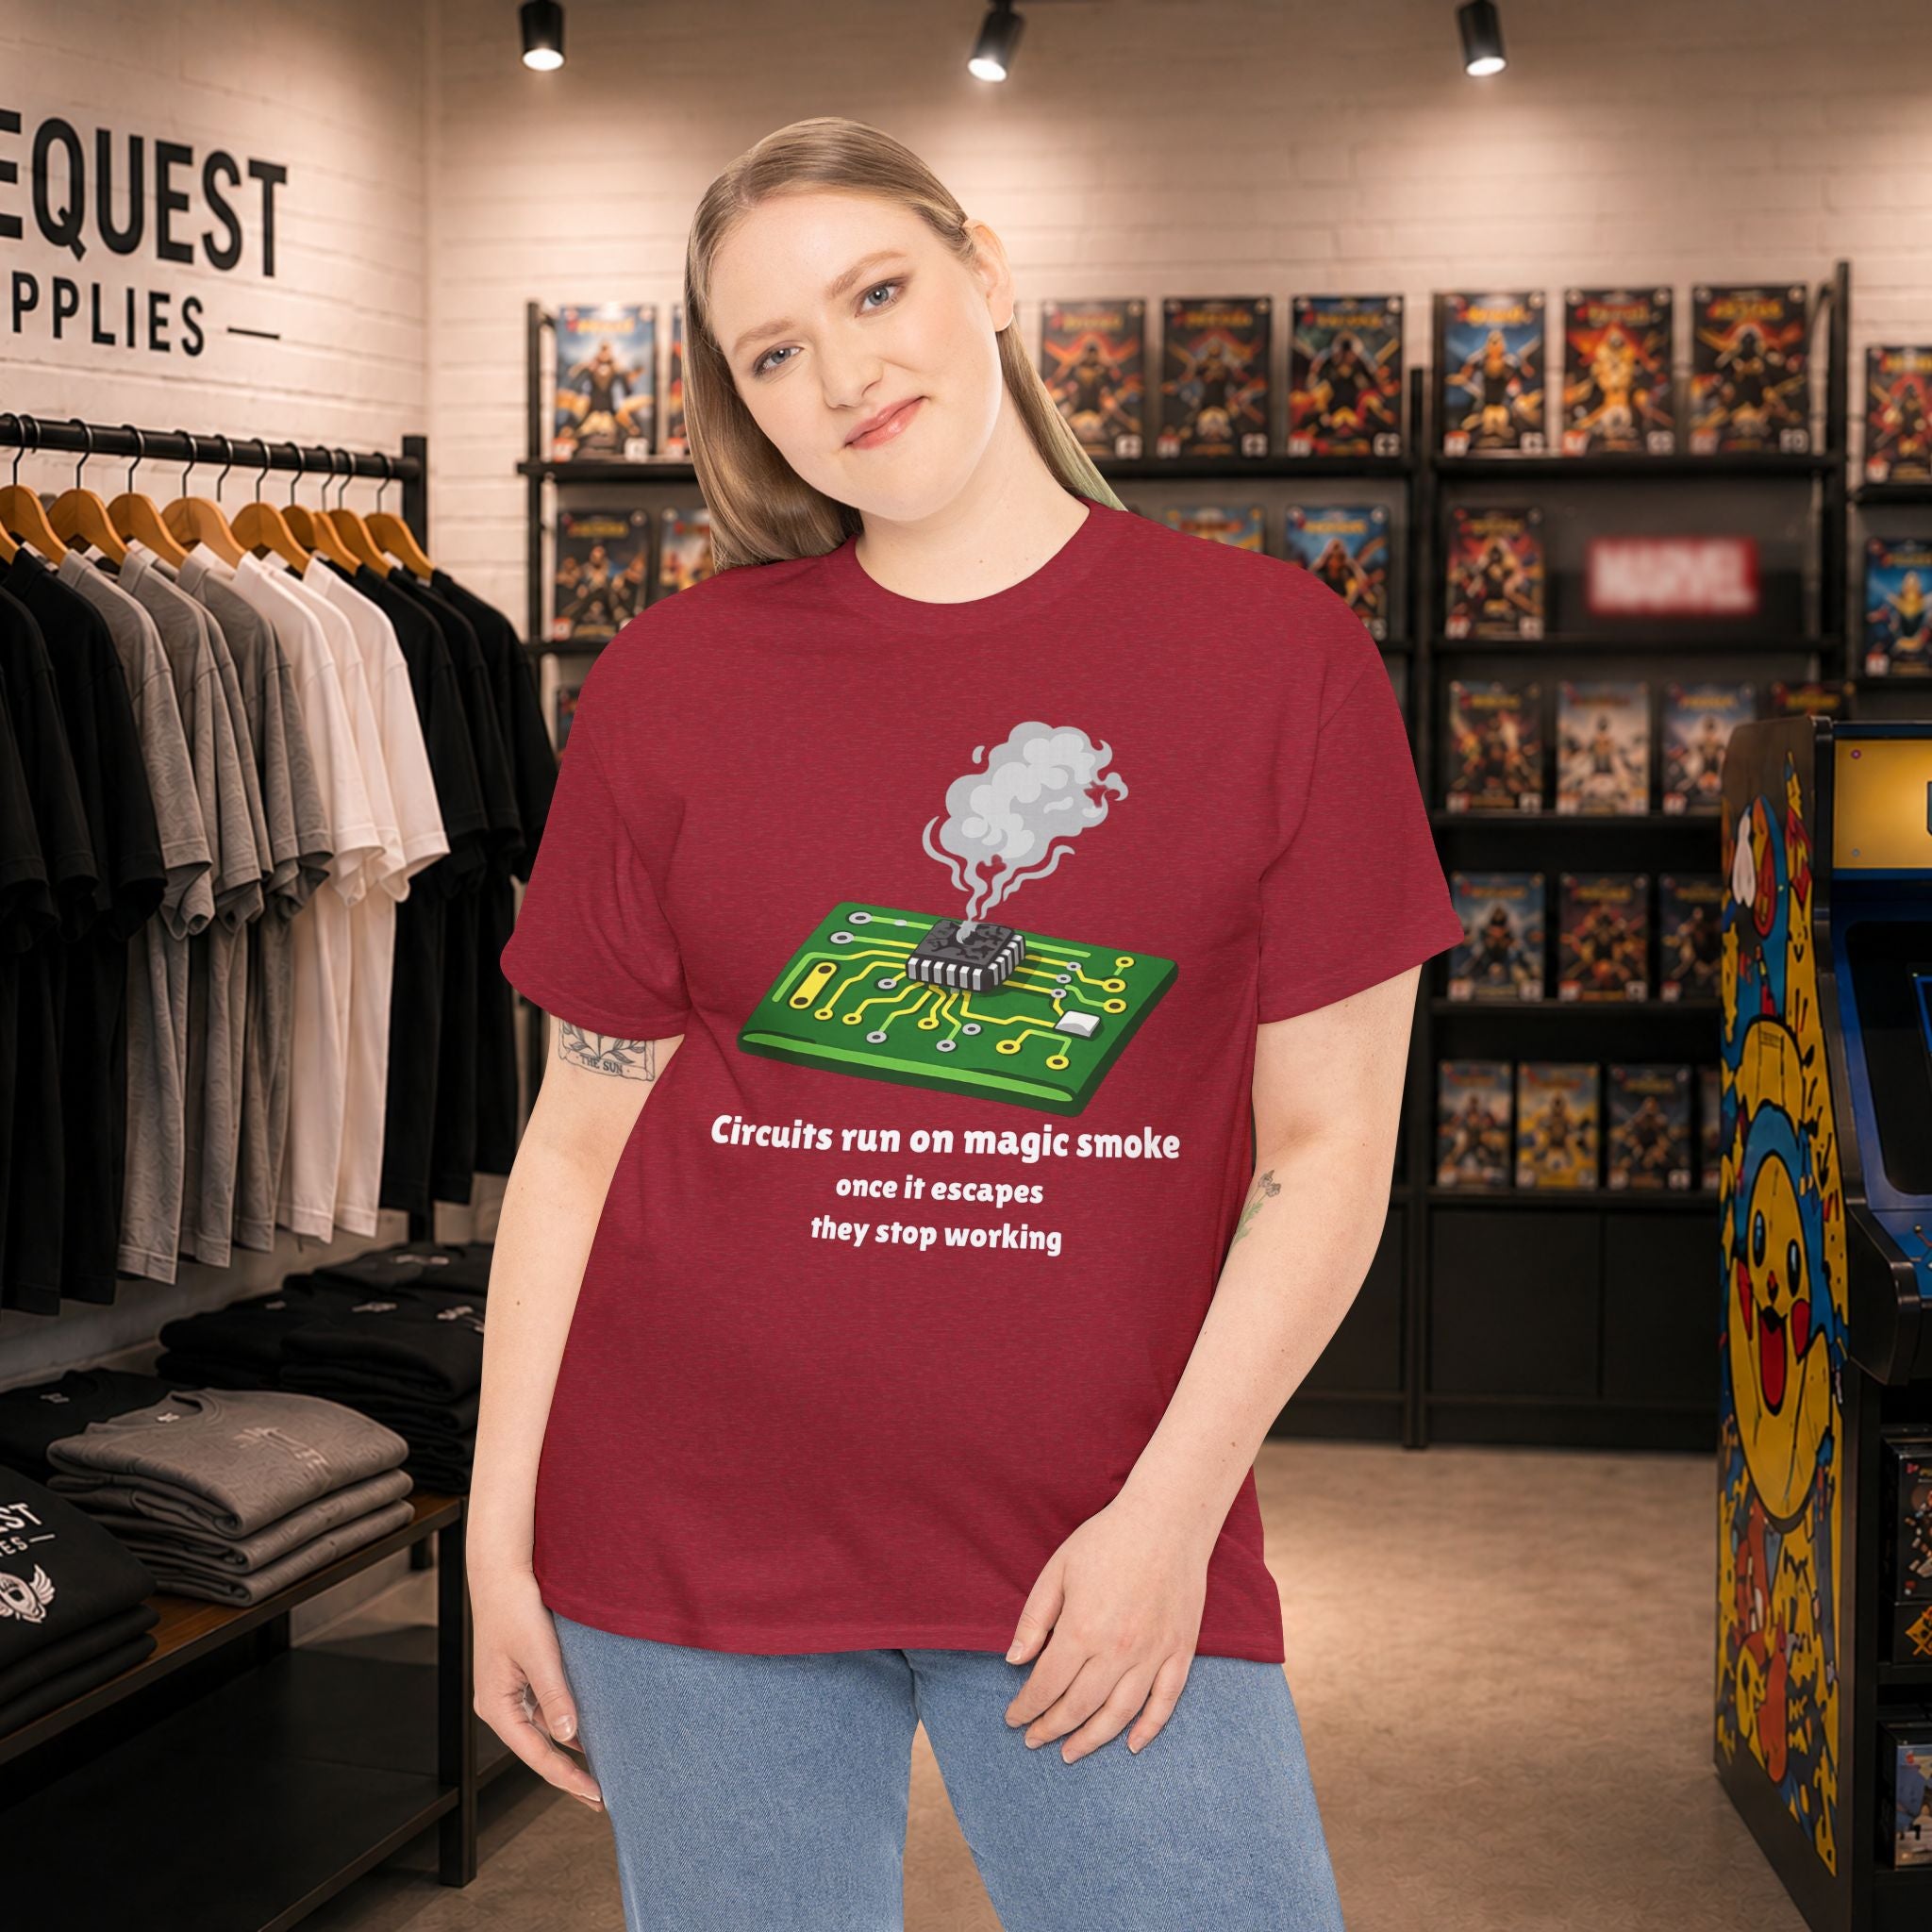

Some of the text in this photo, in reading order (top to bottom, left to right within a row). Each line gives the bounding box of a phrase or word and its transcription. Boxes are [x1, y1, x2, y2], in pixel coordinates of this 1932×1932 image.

[11, 270, 205, 357] PPLIES
[579, 1053, 624, 1074] THE SUN
[710, 1114, 1180, 1164] Circuits run on magic smoke
[835, 1174, 1043, 1209] once it escapes
[810, 1214, 1062, 1257] they stop working
[0, 1503, 42, 1533] ST
[0, 1537, 28, 1556] ES
